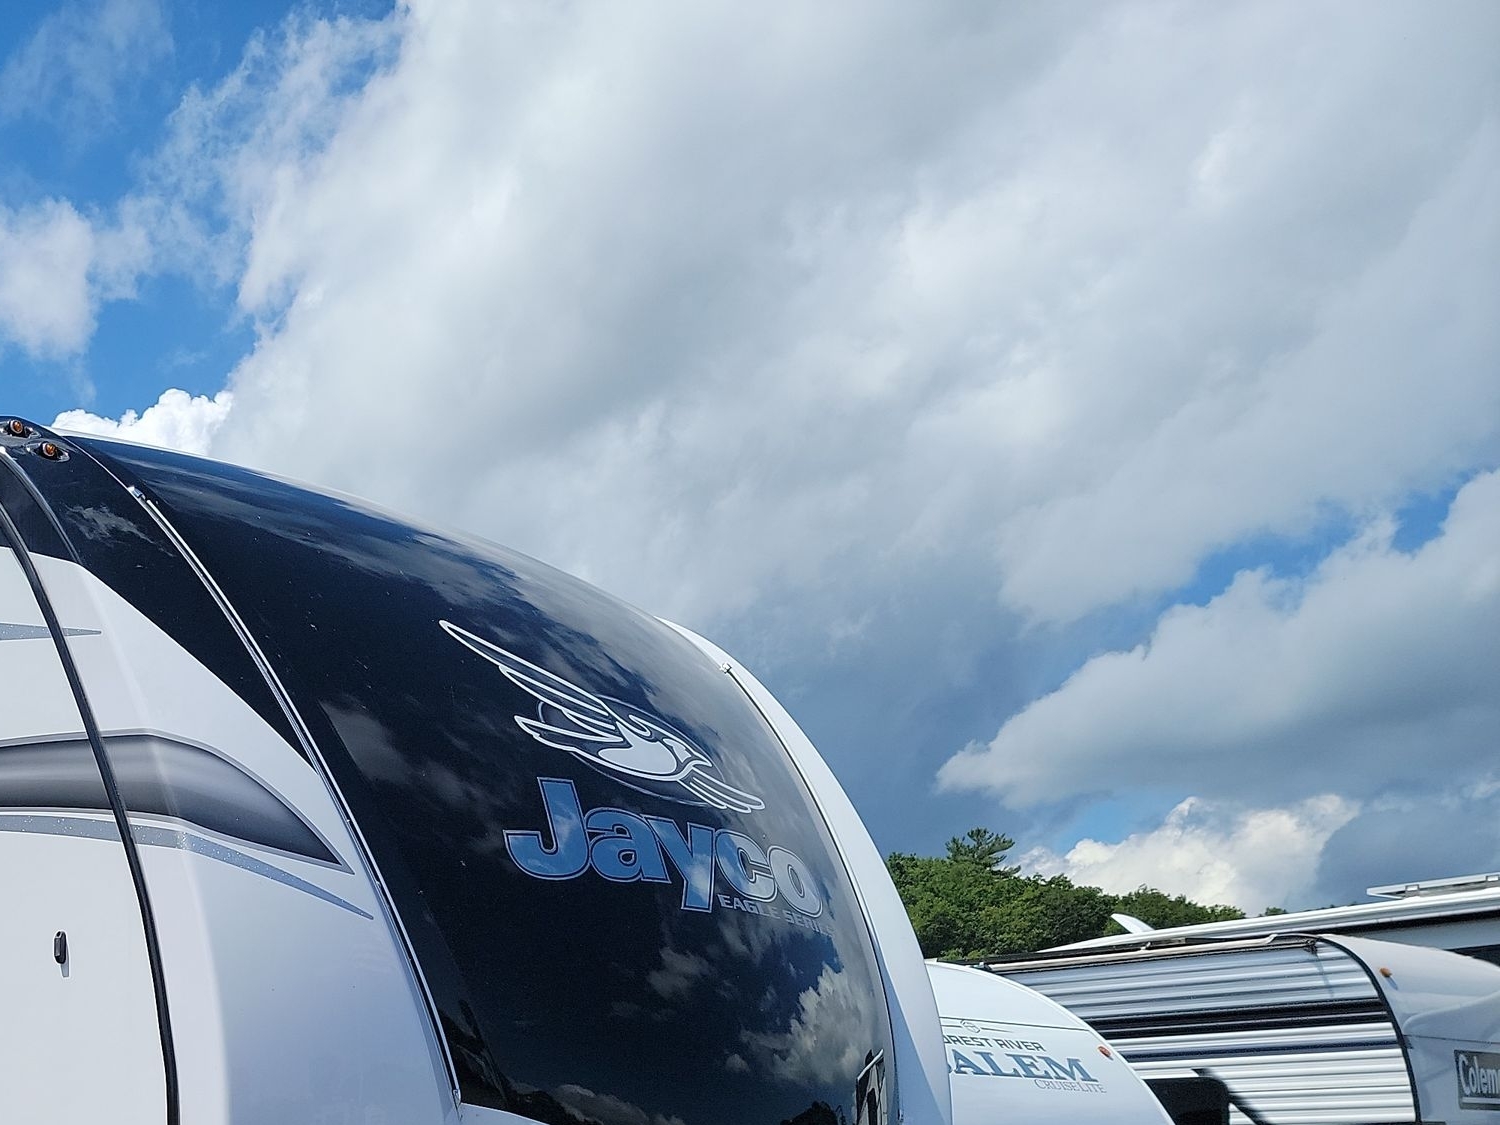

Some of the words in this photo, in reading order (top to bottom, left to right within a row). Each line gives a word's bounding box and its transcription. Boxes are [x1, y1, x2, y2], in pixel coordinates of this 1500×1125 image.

[503, 776, 823, 913] Jayco
[717, 893, 781, 919] EAGLE
[781, 909, 837, 938] SERI
[943, 1034, 994, 1048] OREST
[994, 1038, 1046, 1052] RIVER
[948, 1049, 1099, 1083] ALEM
[1459, 1053, 1500, 1095] Colem
